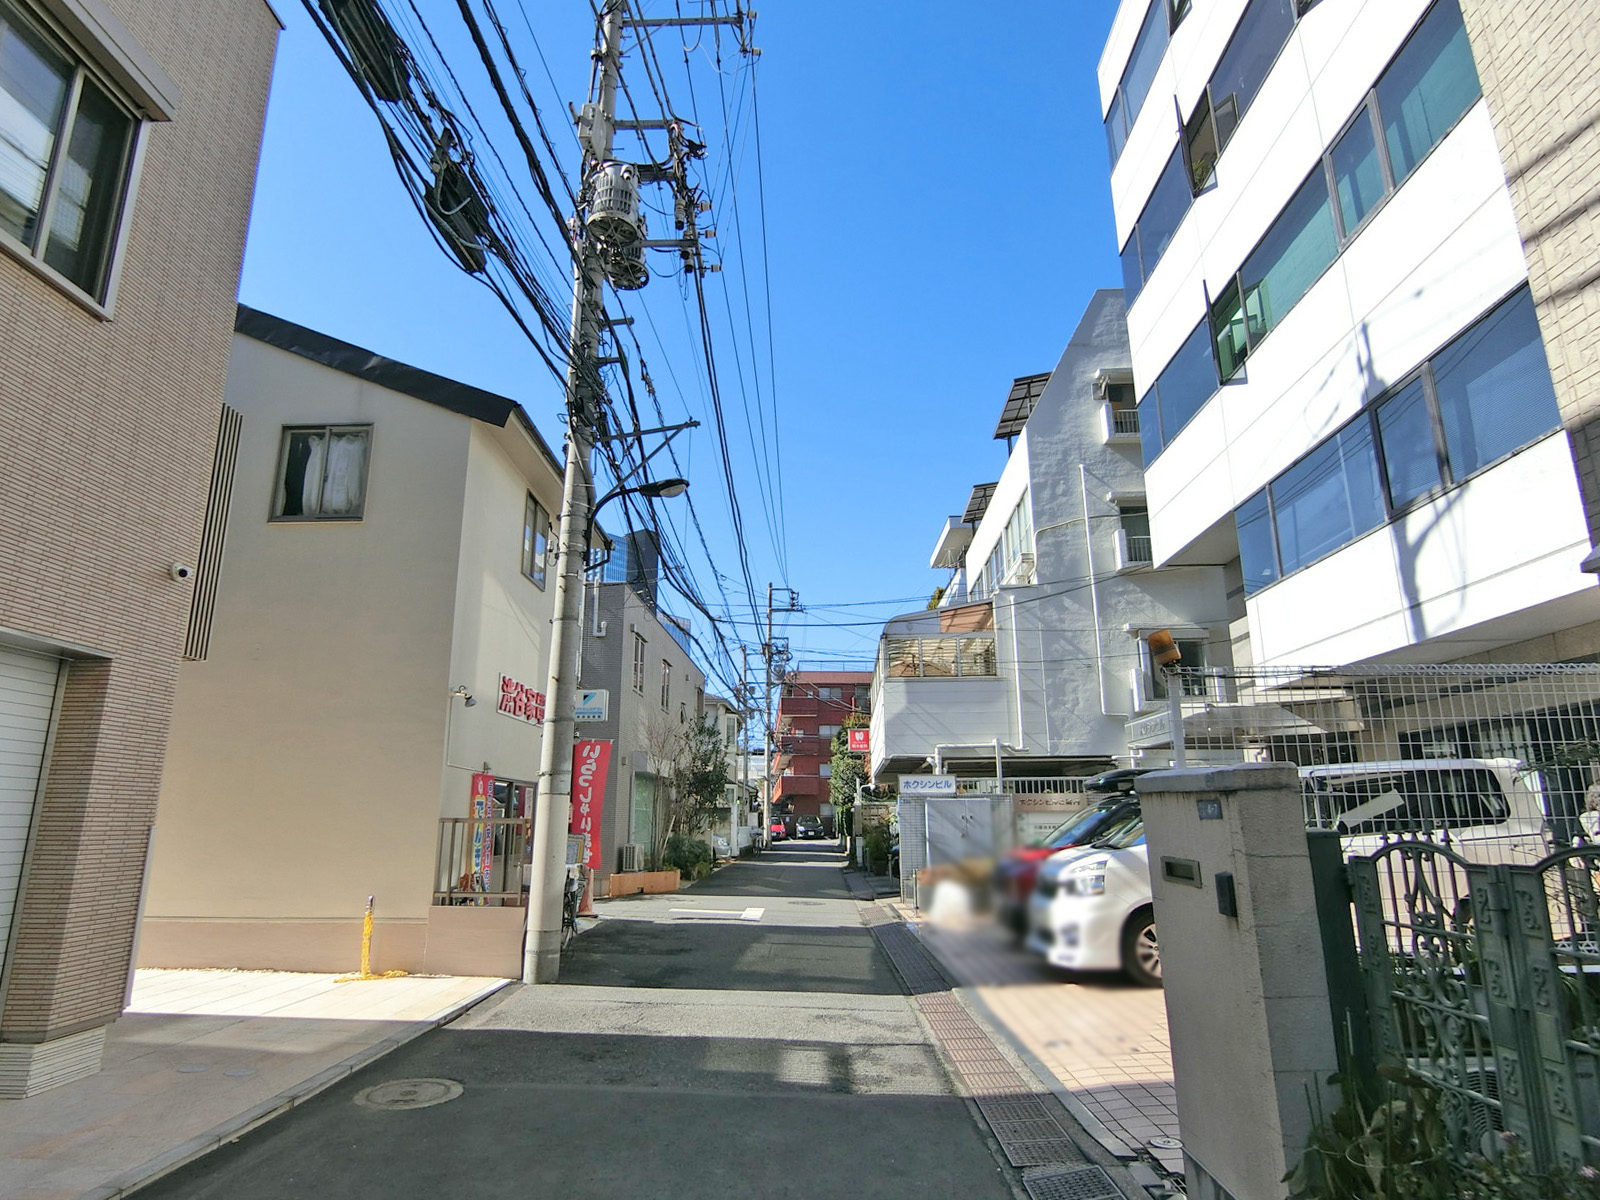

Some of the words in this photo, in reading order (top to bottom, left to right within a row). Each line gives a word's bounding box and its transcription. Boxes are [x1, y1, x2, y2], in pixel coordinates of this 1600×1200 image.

[903, 780, 952, 789] ホクシンビル
